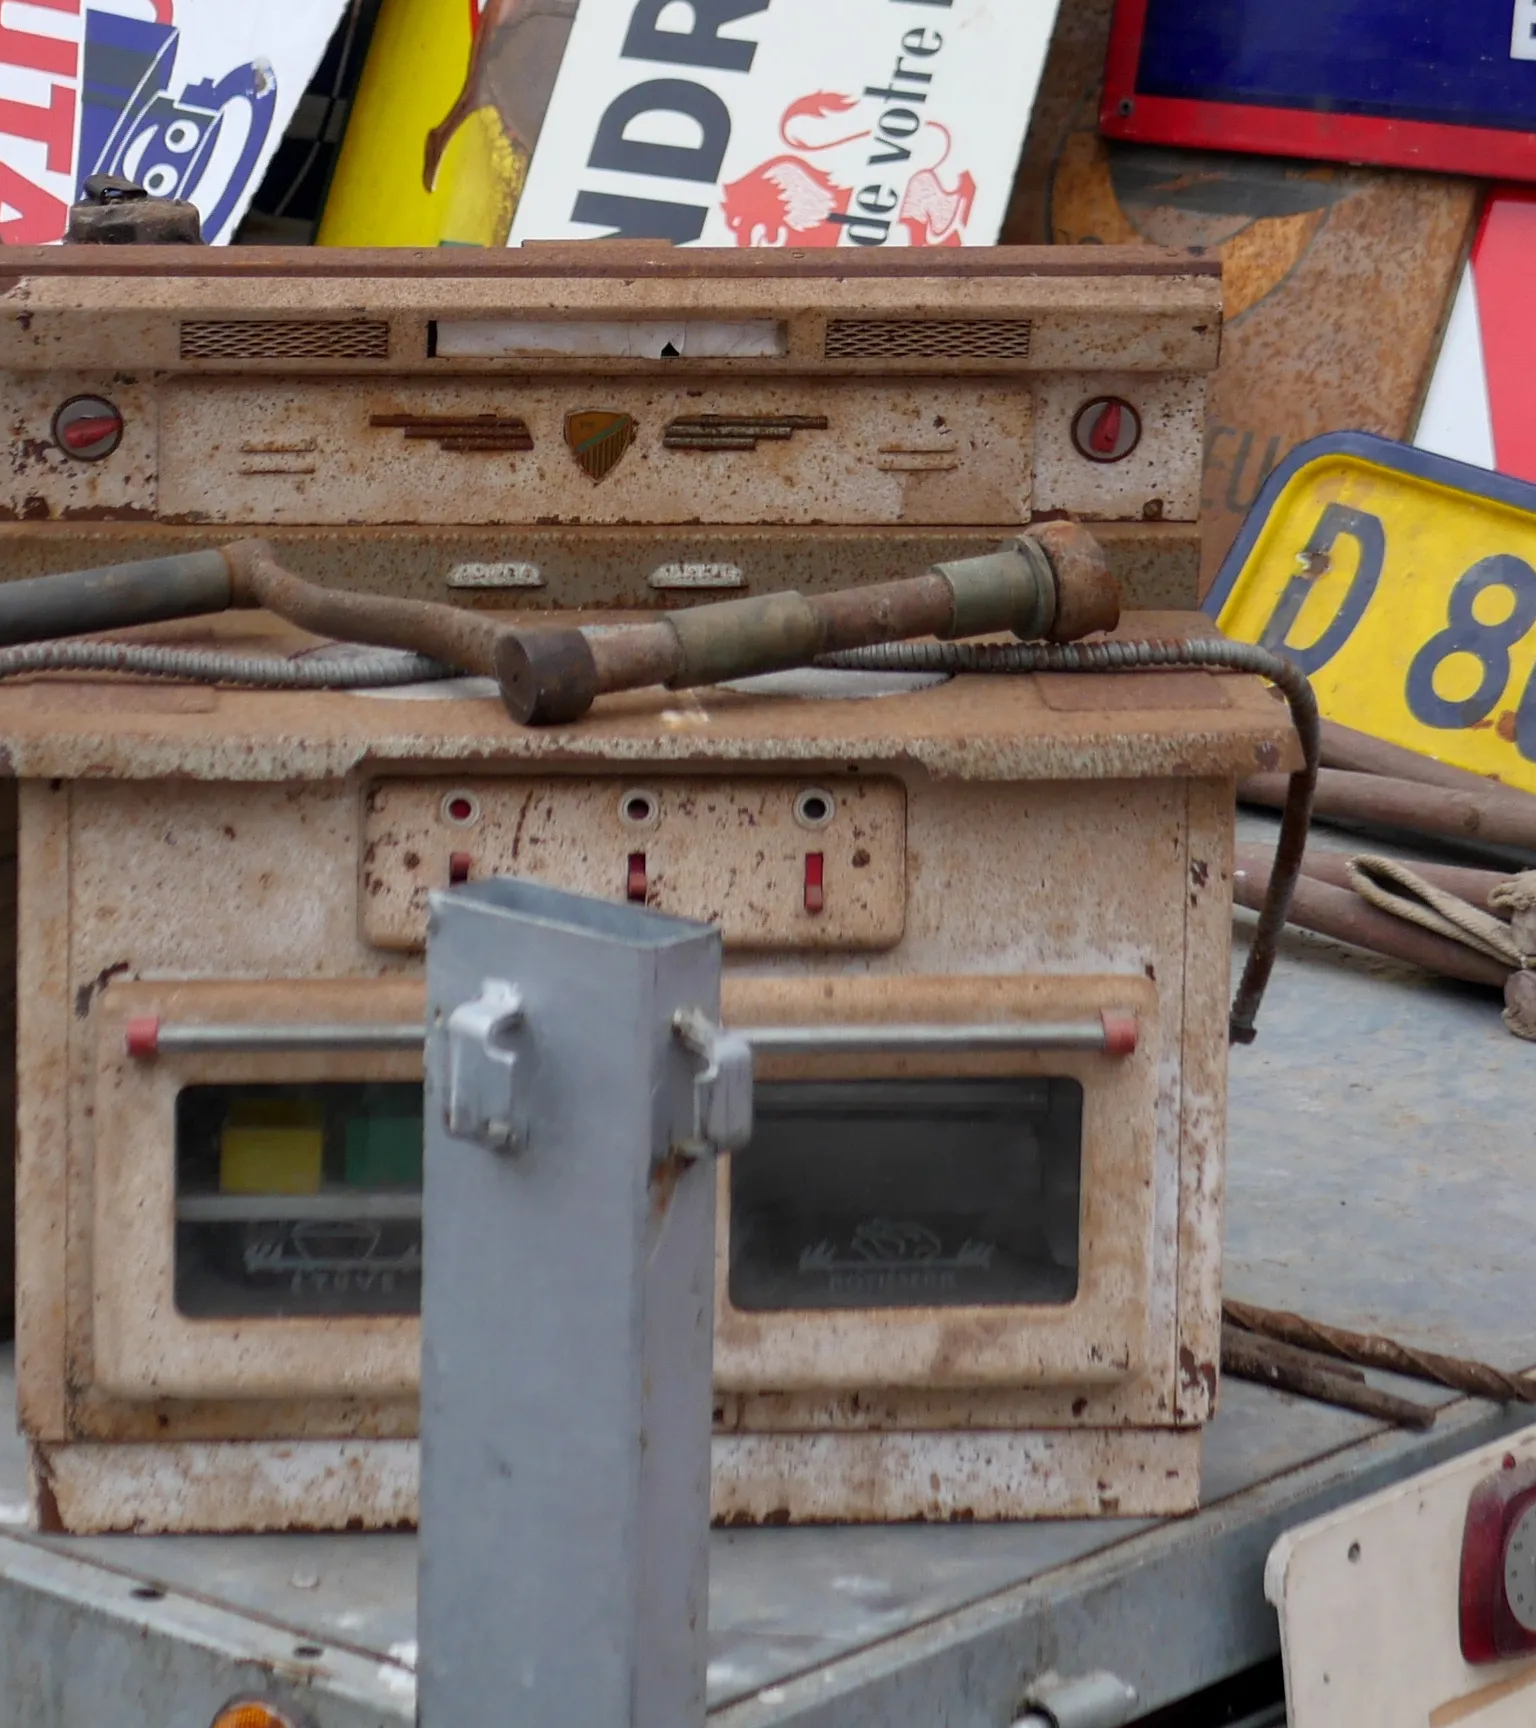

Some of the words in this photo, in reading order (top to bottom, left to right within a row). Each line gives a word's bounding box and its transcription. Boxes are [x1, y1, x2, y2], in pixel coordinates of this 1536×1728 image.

[830, 184, 898, 246] de
[865, 25, 944, 166] votre
[1259, 502, 1385, 677] D
